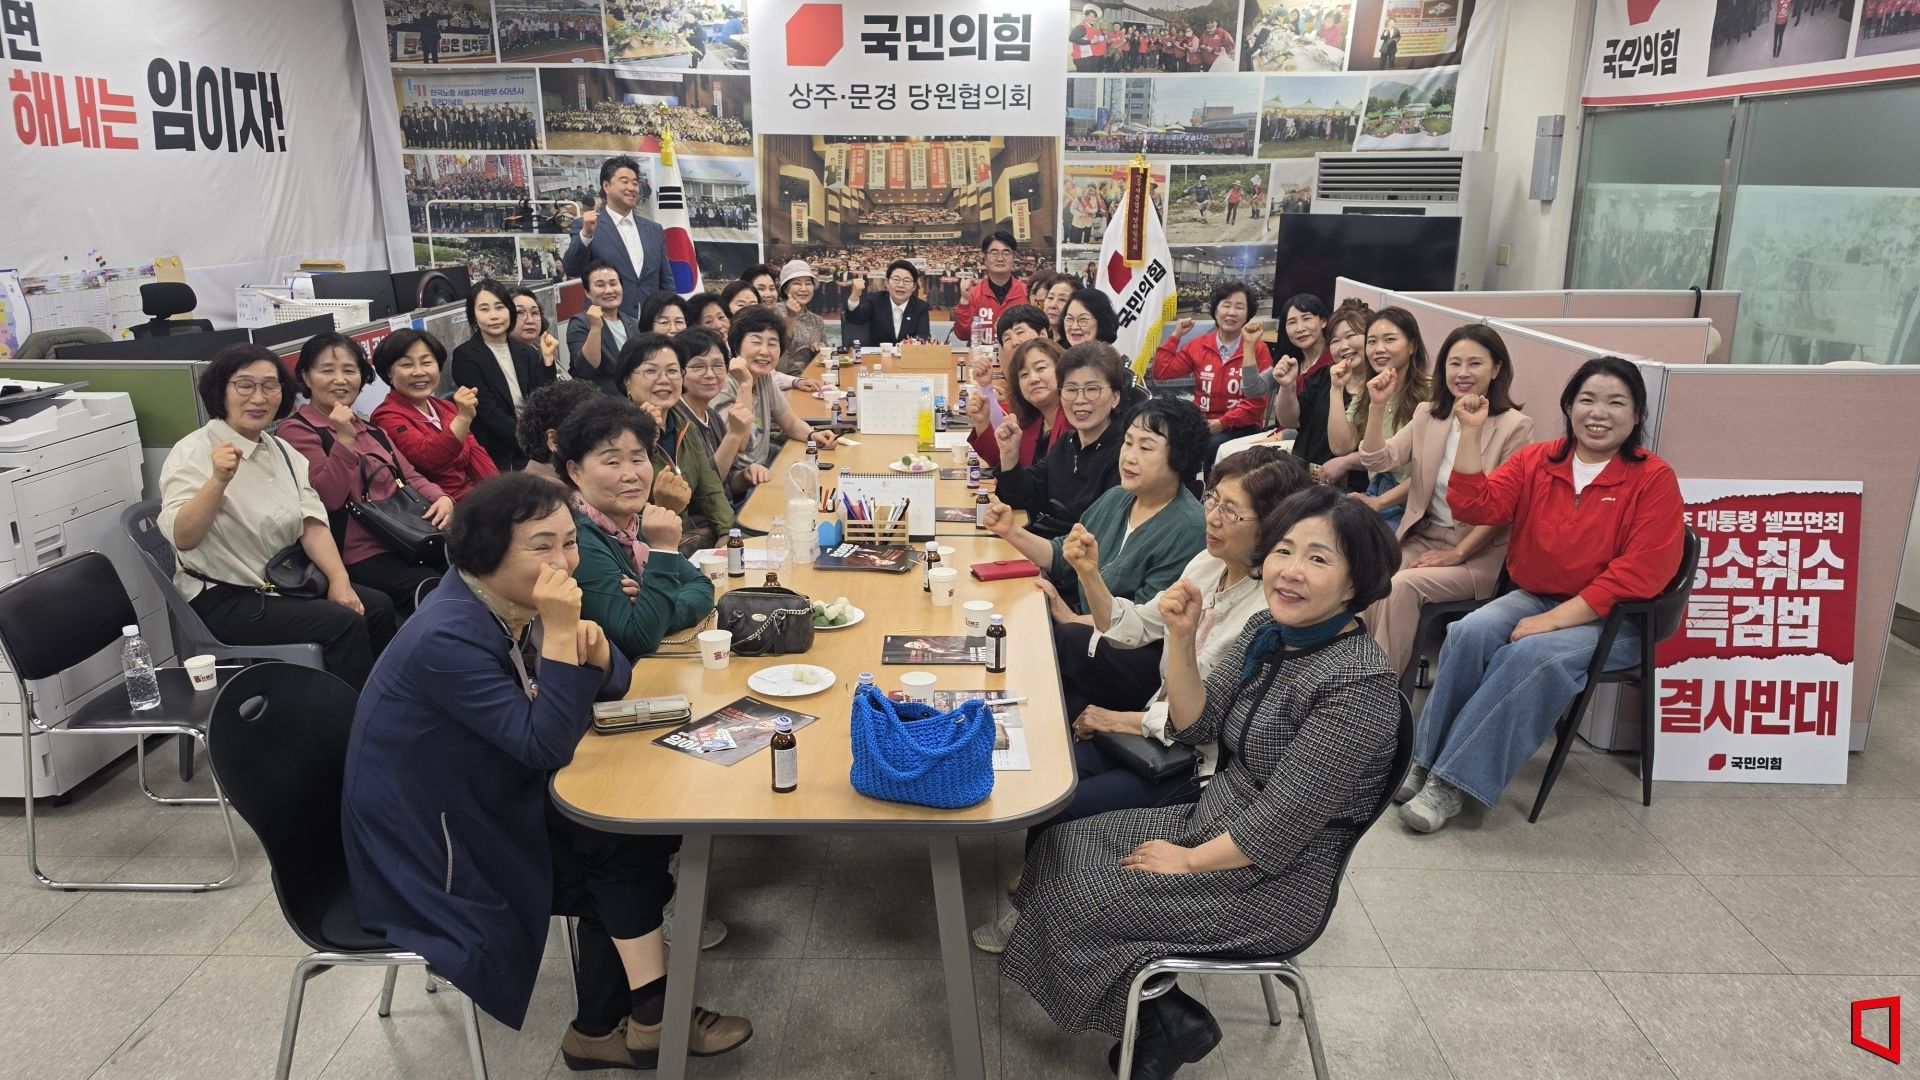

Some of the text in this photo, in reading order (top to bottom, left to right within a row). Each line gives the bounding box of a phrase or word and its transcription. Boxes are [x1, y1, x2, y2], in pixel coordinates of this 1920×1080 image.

[0, 0, 42, 63] 면
[860, 13, 1032, 62] 국민의힘
[1603, 28, 1681, 79] 국민의힘
[9, 57, 287, 153] 해내는 임이자!
[457, 87, 498, 97] 서울지역본부
[499, 86, 525, 96] 60년사
[788, 82, 1032, 111] 상주·문경 당원협의회
[1118, 258, 1168, 329] 국민의힘
[1697, 510, 1758, 533] 대통령
[1762, 510, 1845, 534] 셀프면죄
[1685, 595, 1820, 648] 특검법
[1659, 678, 1840, 736] 결사반대
[1730, 755, 1782, 771] 국민의힘
